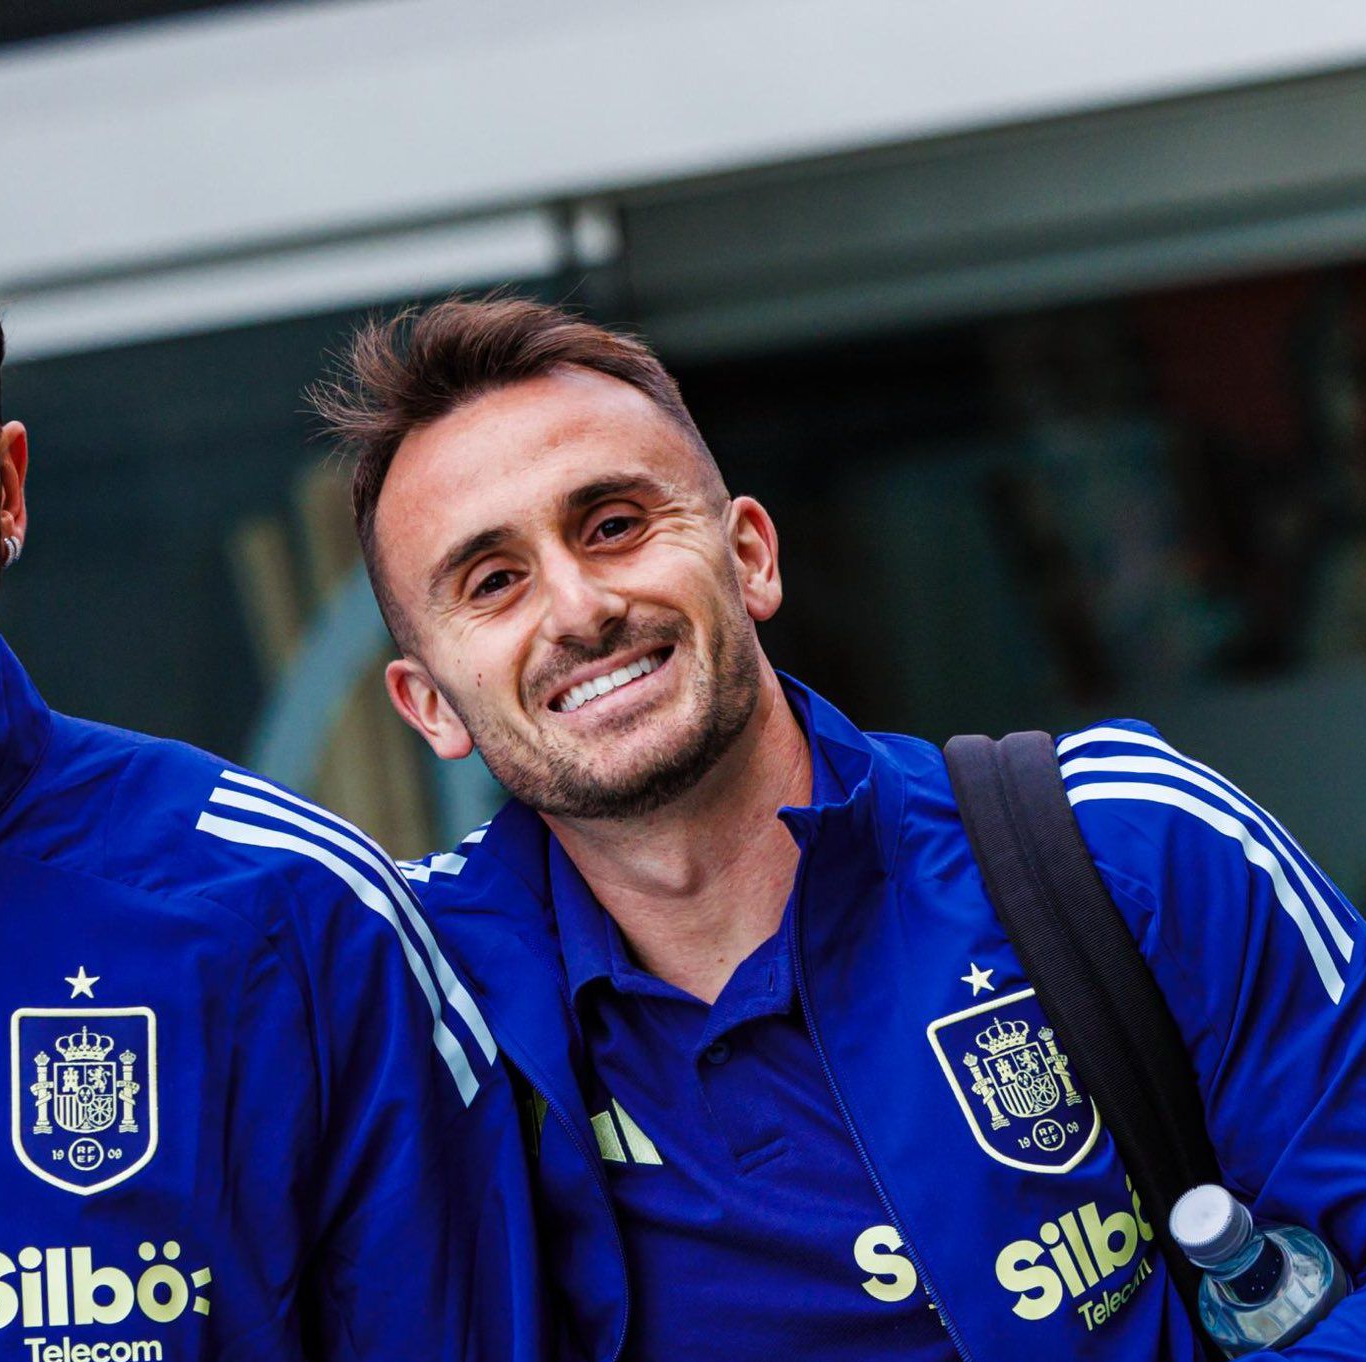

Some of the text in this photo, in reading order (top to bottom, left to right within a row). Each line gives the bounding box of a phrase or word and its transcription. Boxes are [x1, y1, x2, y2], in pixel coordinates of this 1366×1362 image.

[1017, 1136, 1031, 1149] 19
[51, 1148, 123, 1160] 19 09
